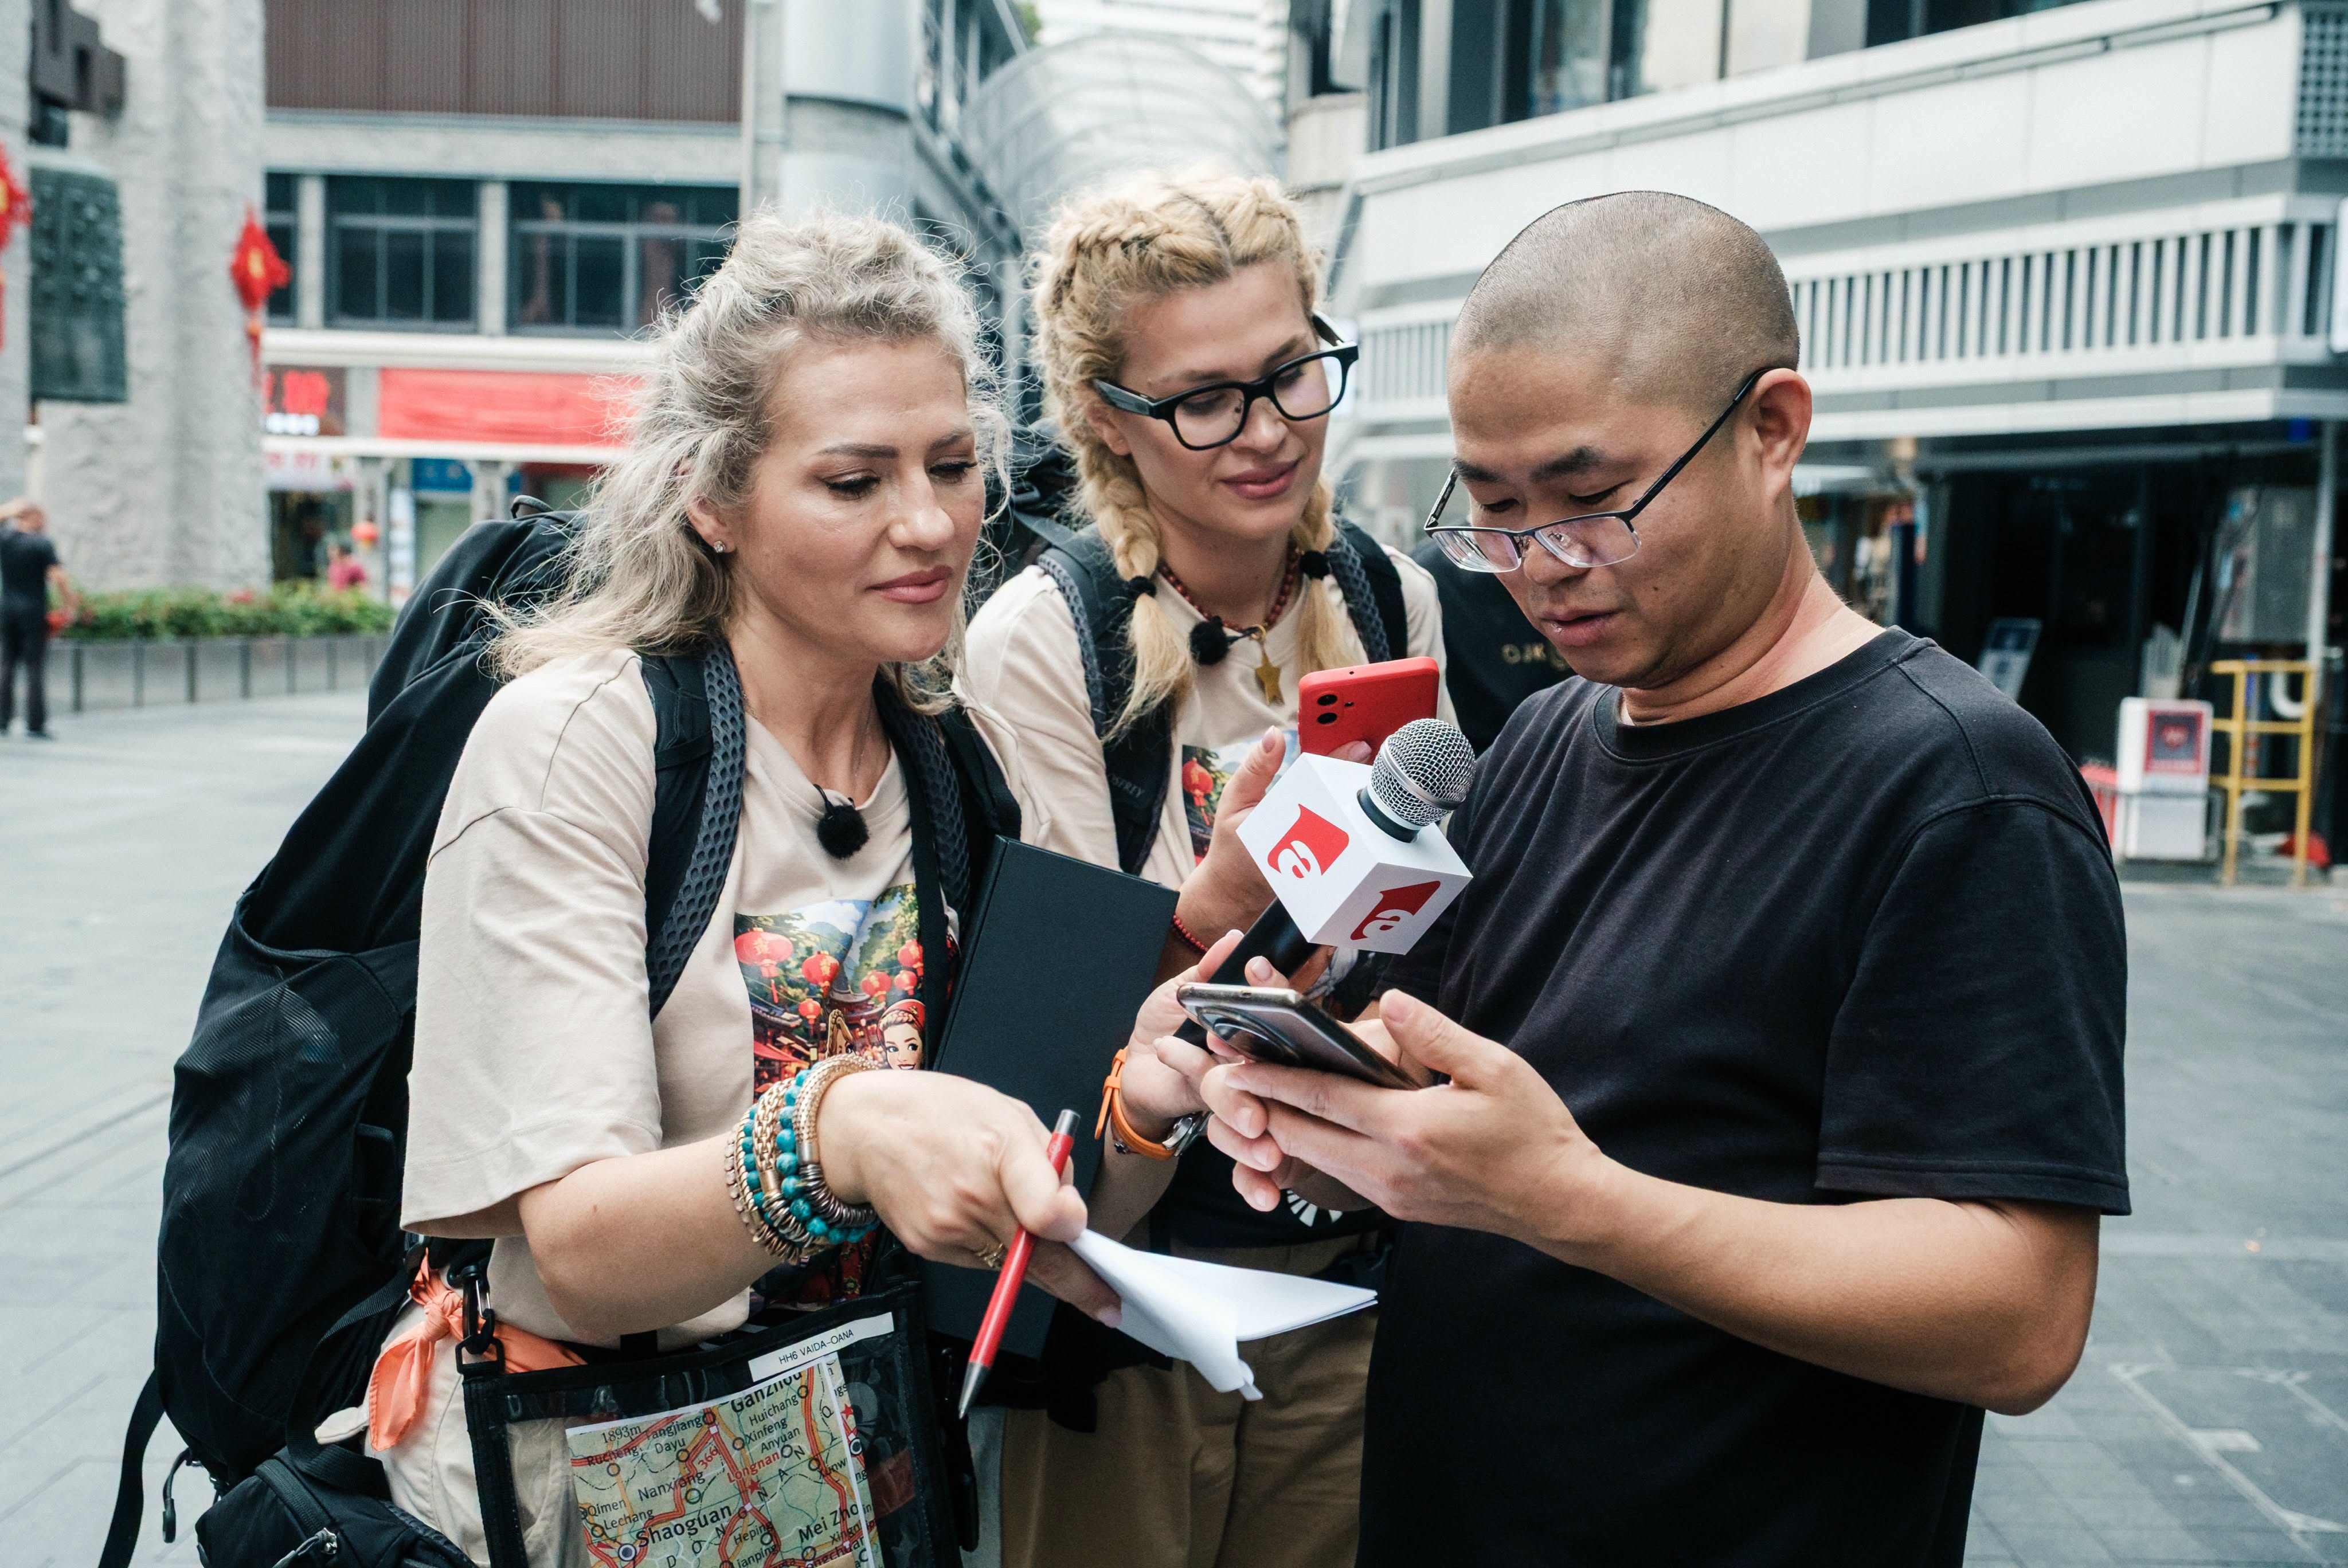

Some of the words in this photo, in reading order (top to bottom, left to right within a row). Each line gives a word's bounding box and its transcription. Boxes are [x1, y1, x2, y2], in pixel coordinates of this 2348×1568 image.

[779, 1351, 798, 1364] HH6
[800, 1329, 854, 1356] VAIDA-OANA
[749, 1393, 799, 1426] Huichang
[601, 1425, 642, 1444] 1893m
[746, 1417, 788, 1444] Xinfeng
[761, 1427, 800, 1453] Anyuan
[587, 1446, 641, 1467] Rucheng
[655, 1438, 686, 1454] Dayu
[698, 1445, 718, 1469] 366
[727, 1451, 780, 1483] Longnan
[637, 1471, 706, 1502] Nanxiong
[587, 1499, 627, 1516] Qimen
[604, 1509, 655, 1530] Lechang
[636, 1505, 731, 1547] Shaoguan
[734, 1521, 774, 1545] Heping
[799, 1516, 828, 1543] Mei
[732, 1544, 778, 1568] ianping
